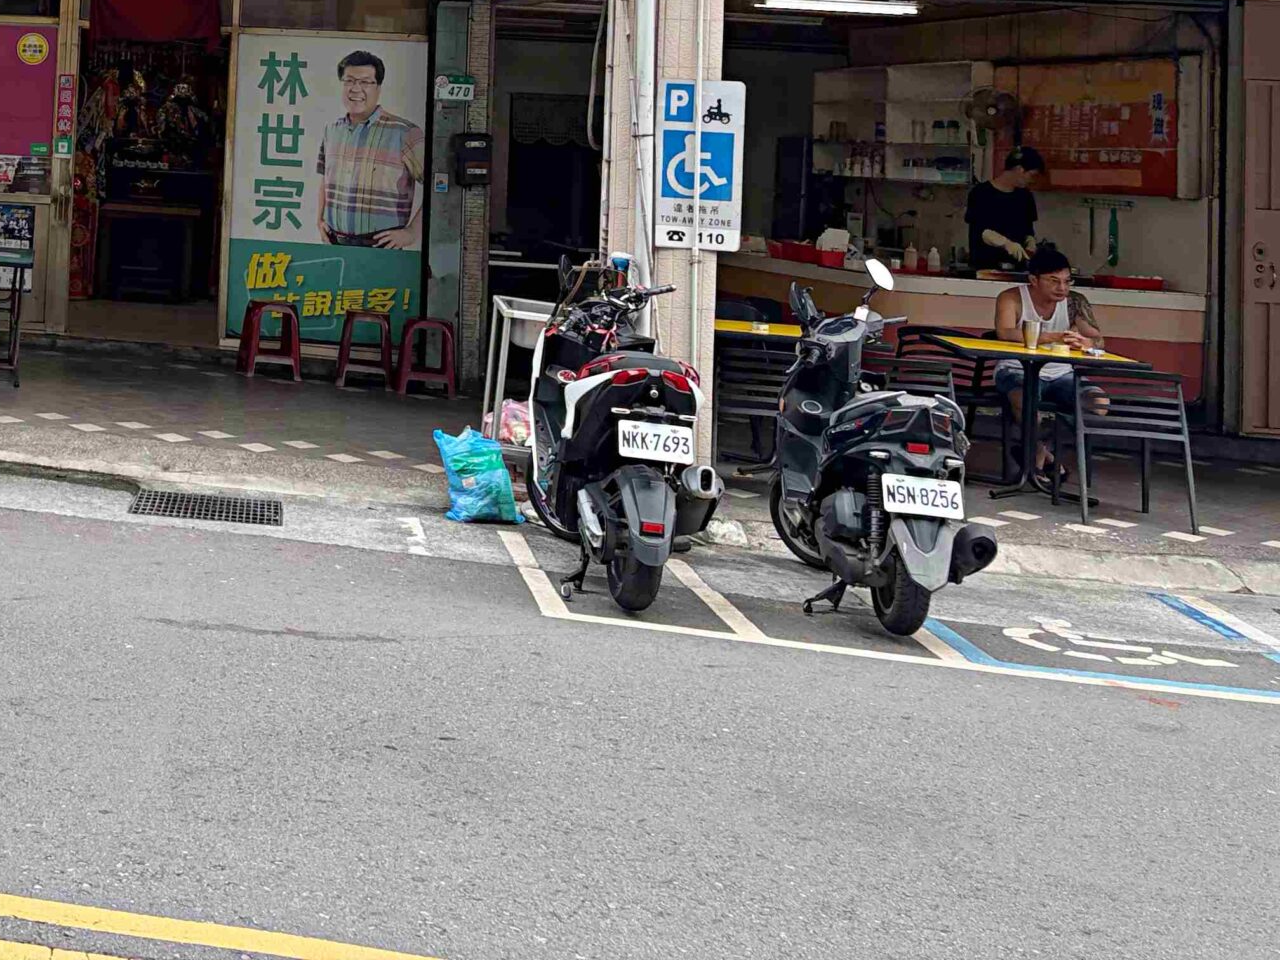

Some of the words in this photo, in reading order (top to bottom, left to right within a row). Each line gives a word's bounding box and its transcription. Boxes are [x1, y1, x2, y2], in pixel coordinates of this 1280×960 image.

[448, 85, 471, 98] 470
[669, 89, 690, 116] P
[252, 51, 309, 231] 林世宗
[661, 215, 705, 226] TOW-AWY
[708, 218, 732, 228] ZONE
[697, 232, 725, 245] 110
[621, 428, 691, 457] NKK-7693
[886, 484, 959, 511] NSN-8256
